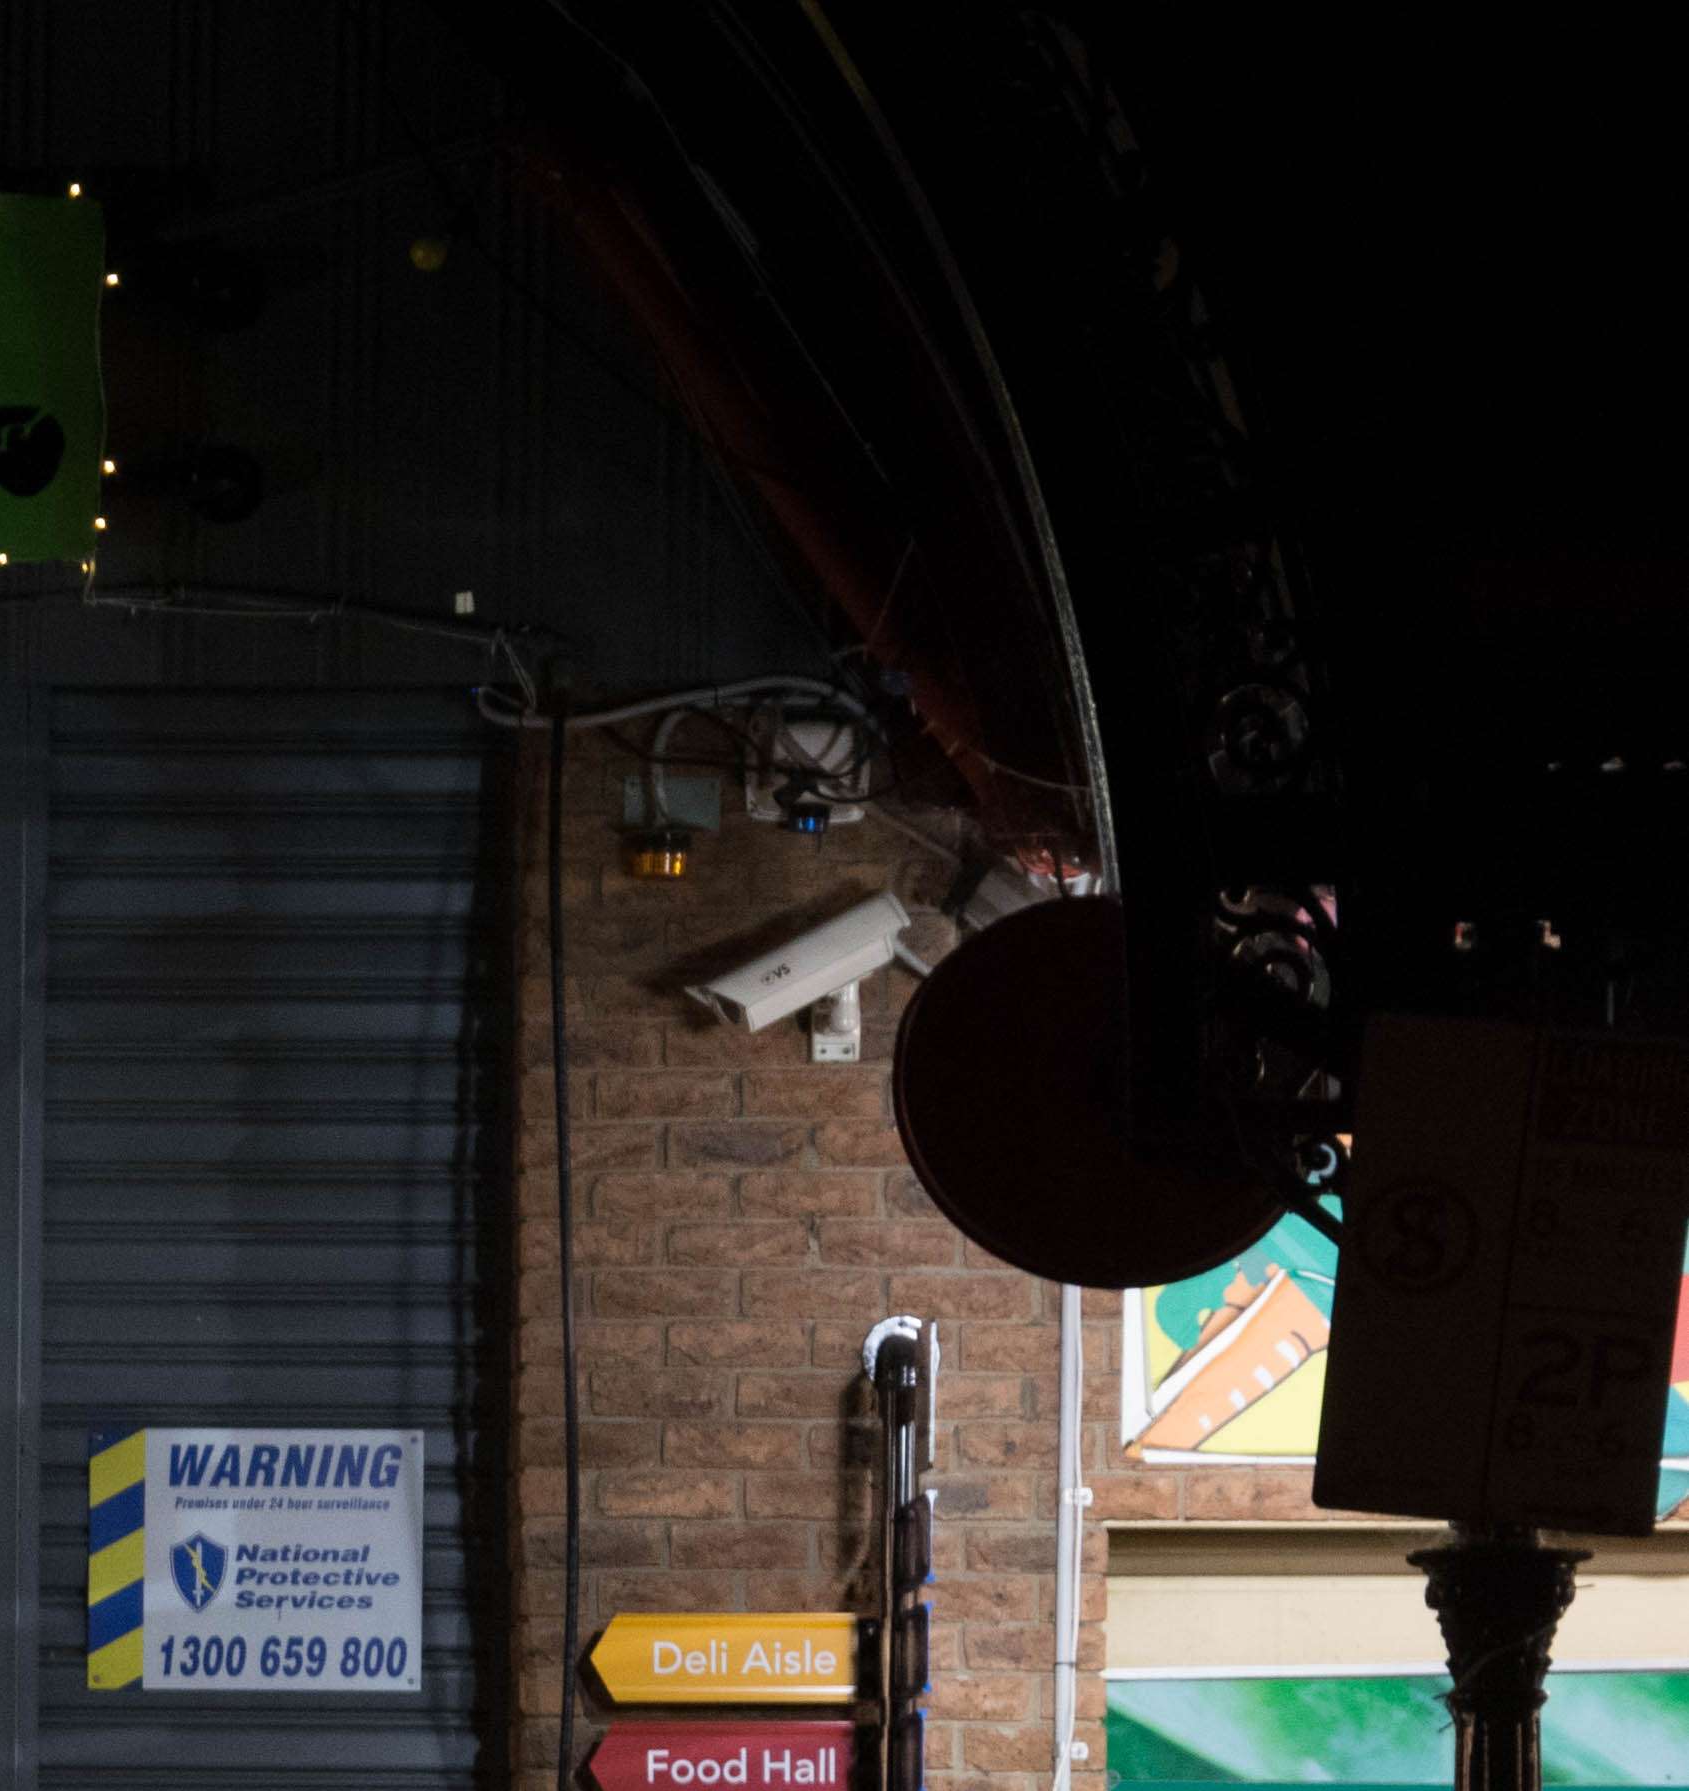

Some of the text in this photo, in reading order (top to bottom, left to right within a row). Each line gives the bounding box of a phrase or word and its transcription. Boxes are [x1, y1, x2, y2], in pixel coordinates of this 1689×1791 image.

[1517, 1328, 1655, 1409] 2P
[168, 1444, 403, 1488] WARNING
[174, 1496, 390, 1510] Premises under 24 hour surveillance
[235, 1544, 370, 1563] National
[234, 1567, 401, 1587] Protective
[234, 1590, 373, 1610] Services
[161, 1634, 407, 1678] 1300 659 800
[652, 1639, 837, 1676] Deli Aisle
[646, 1747, 836, 1784] Food Hall
